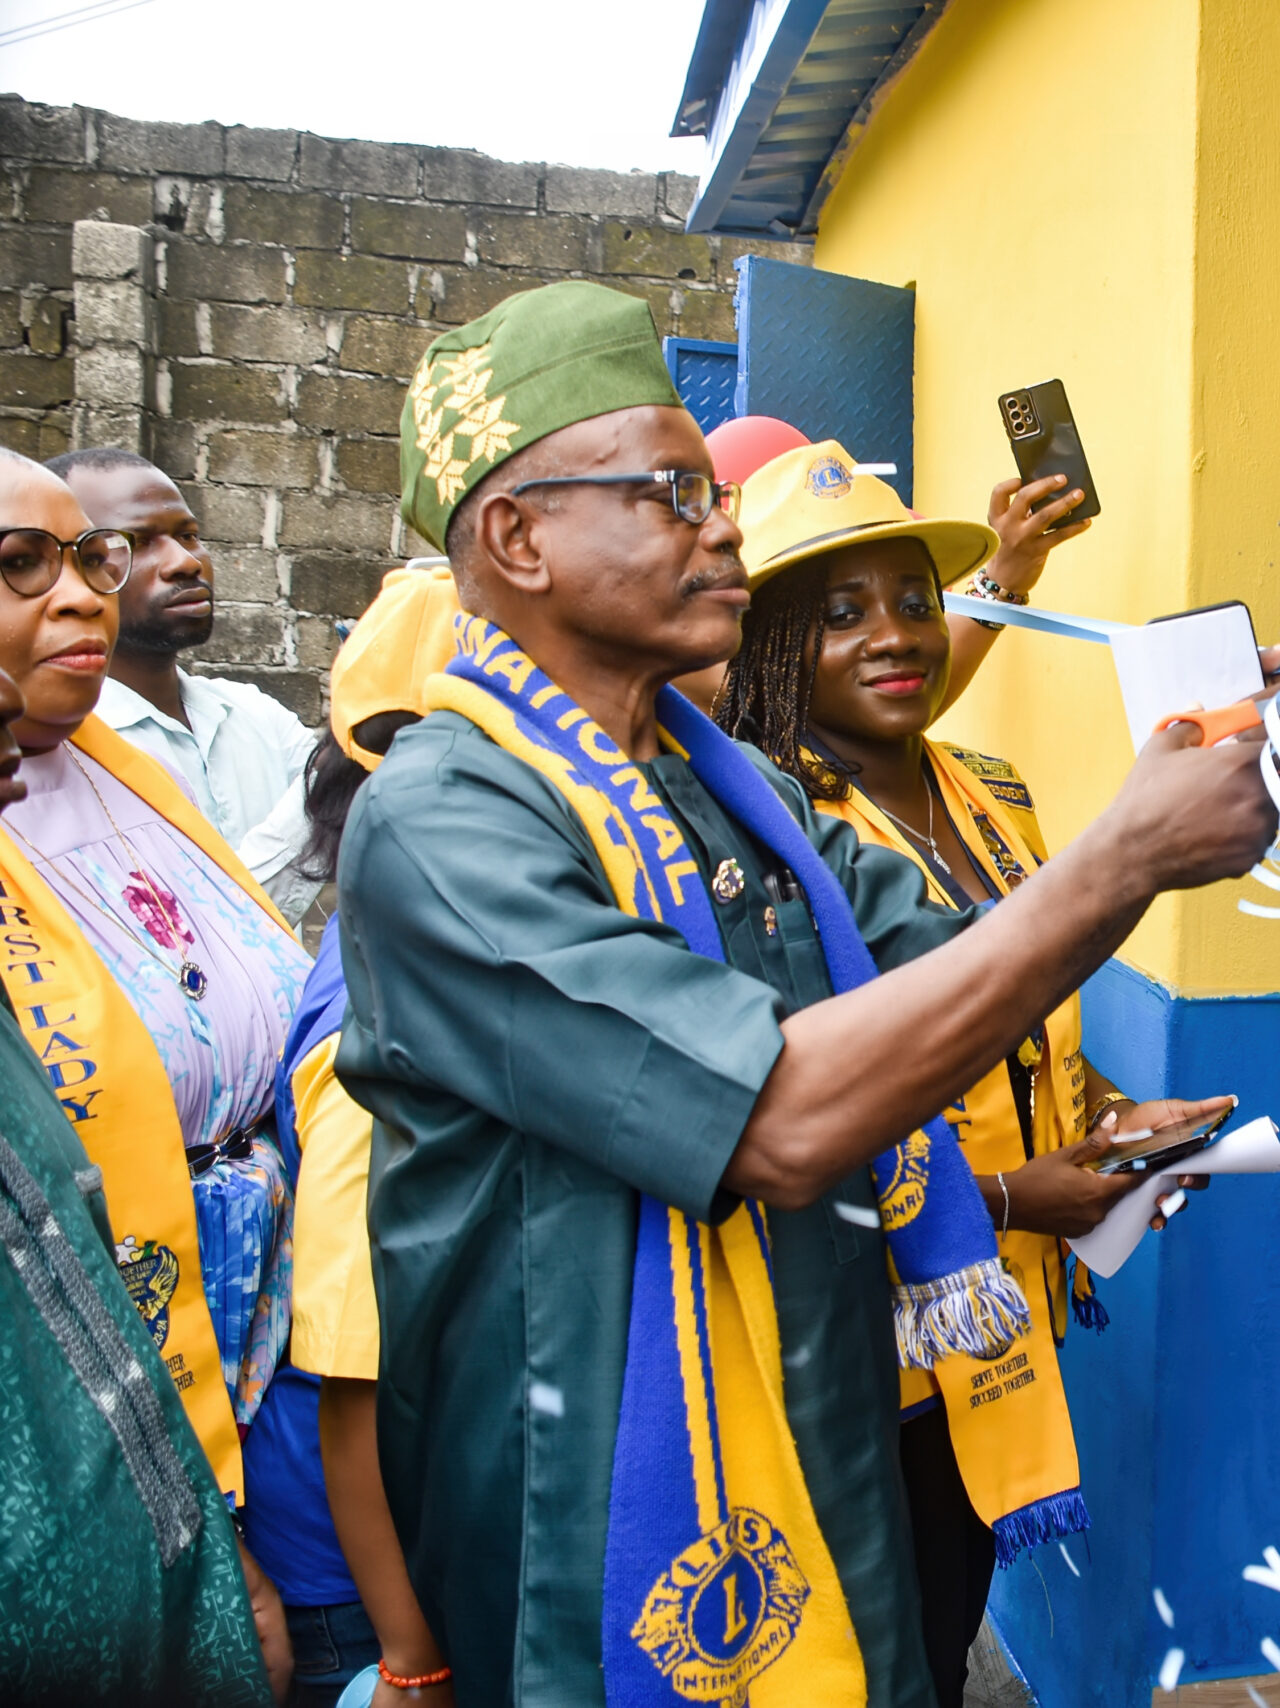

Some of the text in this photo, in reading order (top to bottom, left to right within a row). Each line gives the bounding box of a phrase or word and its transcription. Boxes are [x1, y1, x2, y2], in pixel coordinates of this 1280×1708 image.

[23, 1003, 105, 1125] LADY
[969, 1368, 1037, 1410] SUCCEED TOGETHER
[971, 1352, 1029, 1390] SERVE TOGETHER
